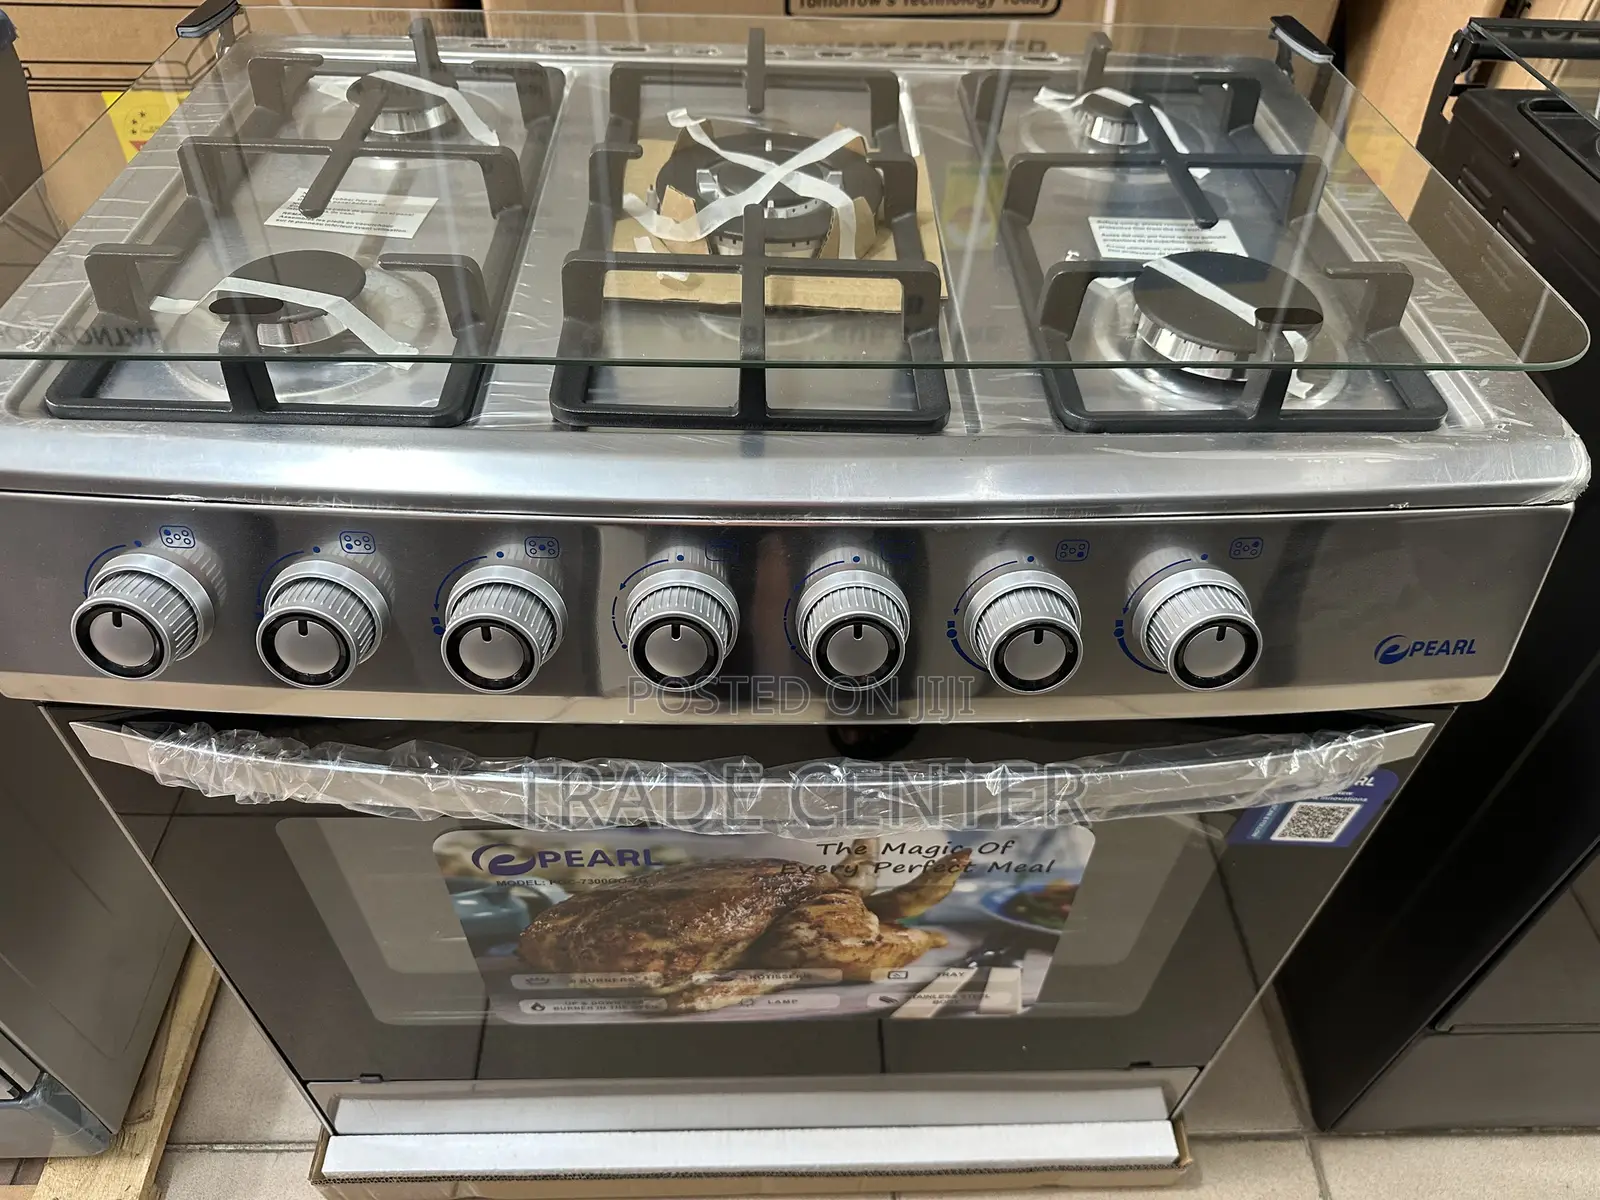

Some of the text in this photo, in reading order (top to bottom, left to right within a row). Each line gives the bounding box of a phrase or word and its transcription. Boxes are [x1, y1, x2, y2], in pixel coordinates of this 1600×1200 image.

[1408, 638, 1476, 657] PEARL
[537, 848, 662, 869] PEARL
[816, 839, 1016, 859] The Magic Of
[779, 859, 1057, 878] Every Perfect Meal
[496, 878, 546, 888] MODEL:
